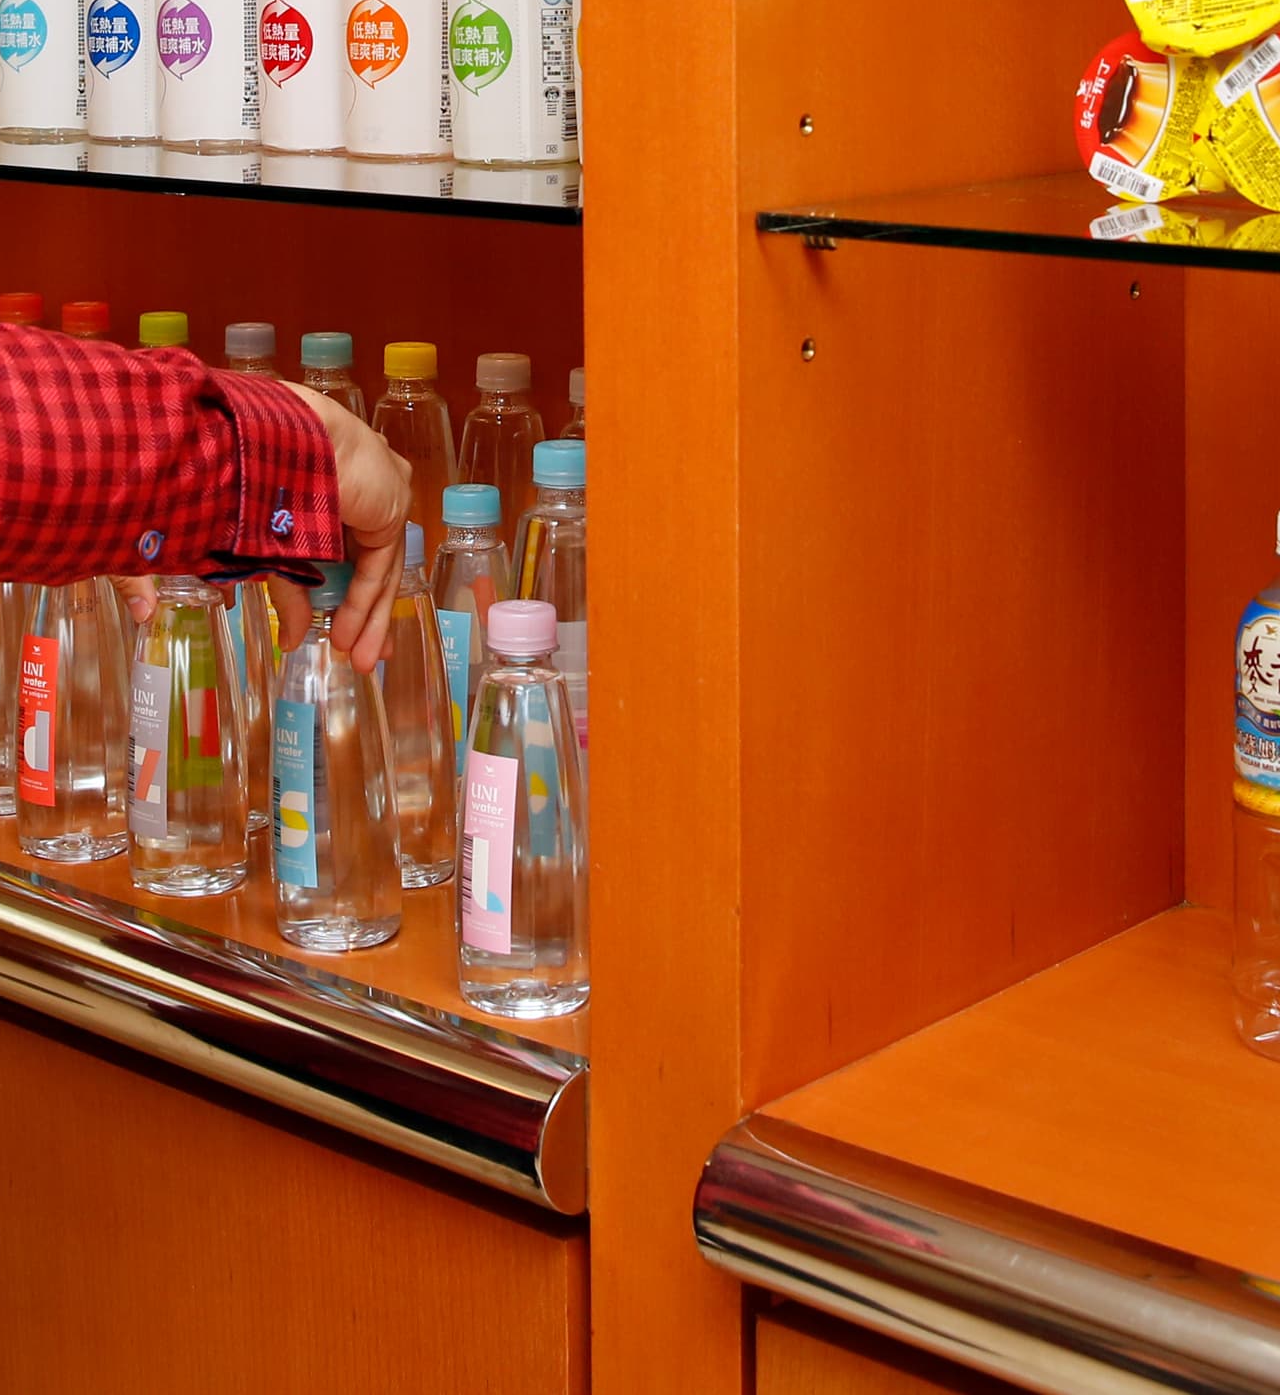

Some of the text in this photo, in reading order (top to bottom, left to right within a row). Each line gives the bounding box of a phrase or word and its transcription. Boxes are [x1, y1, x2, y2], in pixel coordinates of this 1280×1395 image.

[0, 13, 36, 29] 低熱量
[90, 17, 129, 34] 低熱量
[161, 17, 201, 35] 低熱量
[262, 21, 300, 42] 低熱量
[352, 20, 396, 41] 低熱量
[454, 25, 500, 46] 低熱量
[23, 660, 45, 678] UNI
[23, 677, 48, 689] water
[133, 688, 156, 706] UNI
[133, 706, 159, 718] water
[276, 727, 299, 745] UNI
[277, 746, 303, 757] water
[471, 782, 498, 803] UNI
[471, 802, 504, 817] water
